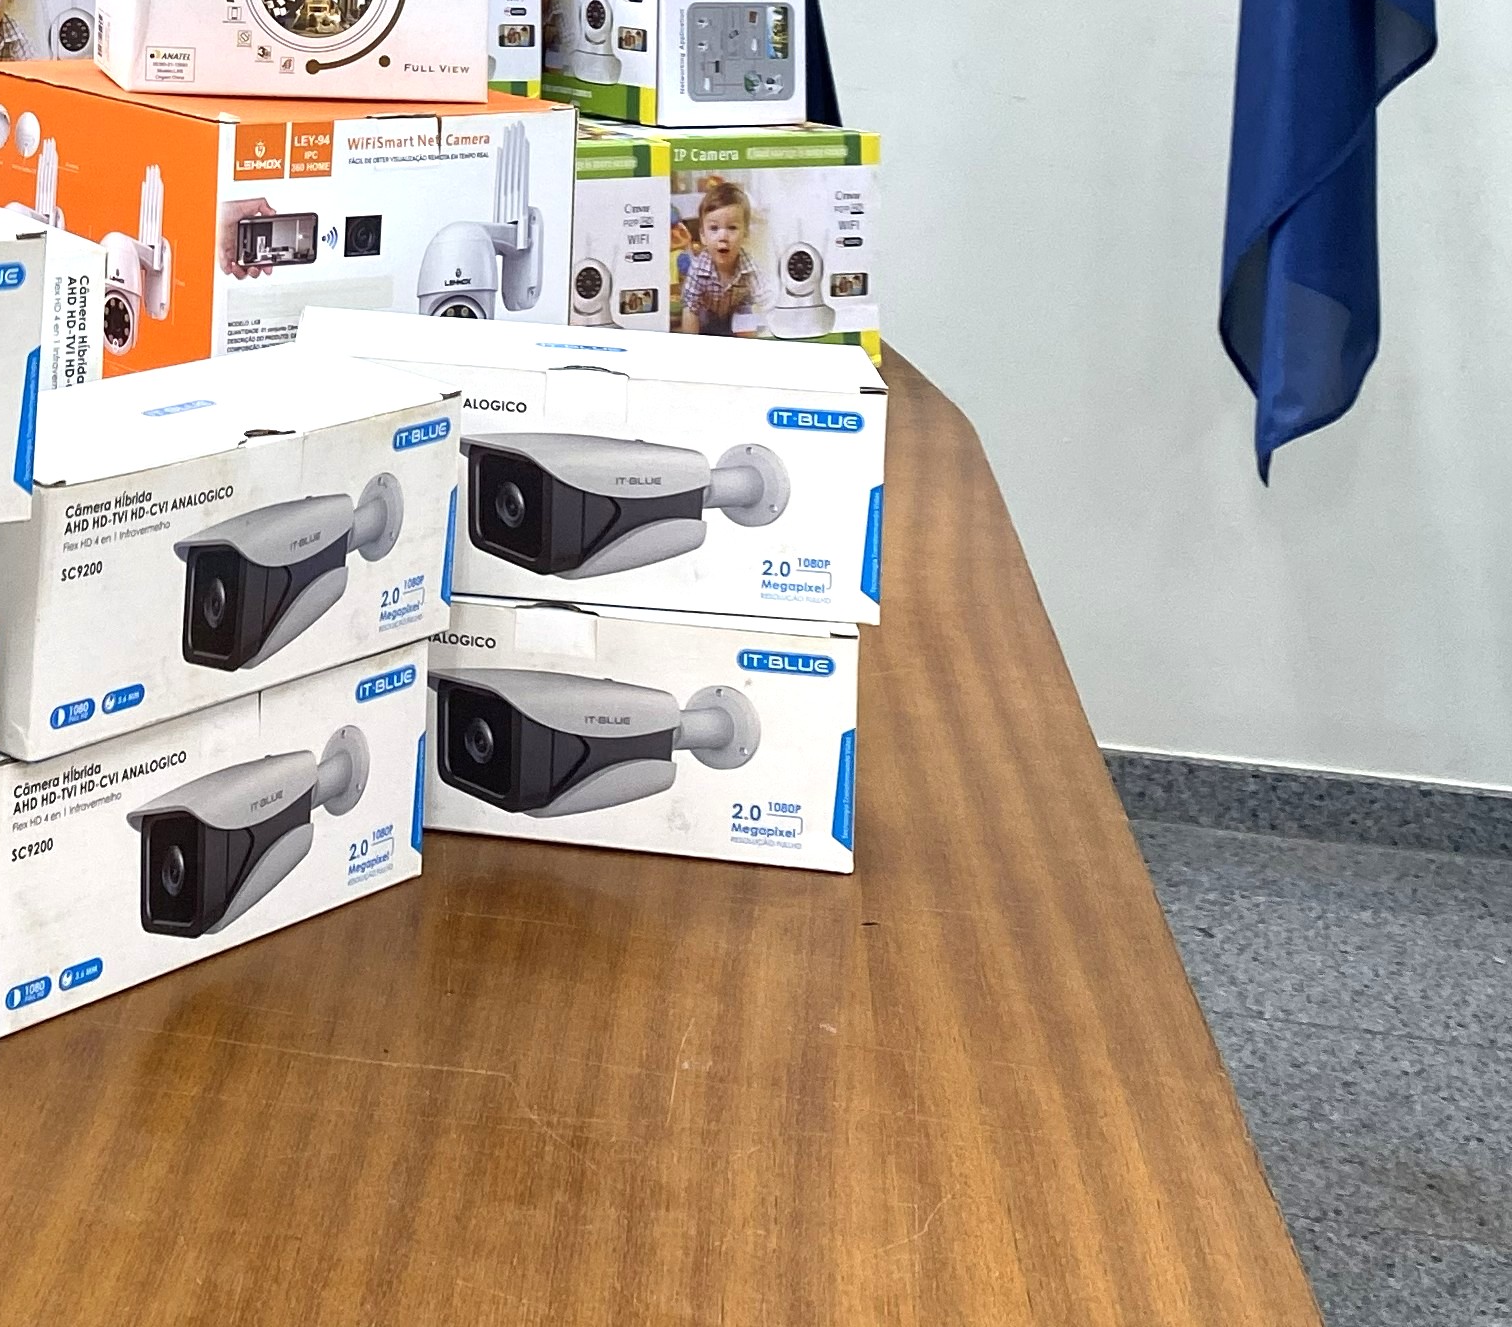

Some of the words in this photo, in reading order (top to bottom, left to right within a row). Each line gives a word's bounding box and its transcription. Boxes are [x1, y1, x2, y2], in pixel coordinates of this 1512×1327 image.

[404, 63, 433, 74] FULL
[440, 63, 470, 74] VIEW
[294, 135, 330, 148] LEY-94
[446, 133, 490, 147] Camera
[304, 151, 318, 160] IPC
[674, 149, 686, 162] IP
[691, 147, 739, 162] Camera
[306, 162, 330, 172] HOME
[68, 276, 77, 305] AHD
[78, 275, 89, 331] Câmera
[66, 310, 76, 354] HD-TVI
[463, 398, 527, 414] ALOGICO
[64, 521, 89, 535] AHD
[92, 511, 127, 529] HD-TVI
[131, 502, 168, 520] HD-CVI
[171, 485, 233, 511] ANALOGICO
[65, 500, 111, 519] Câmera
[61, 561, 102, 581] SC9200
[762, 560, 790, 578] 2.0
[797, 558, 831, 569] 1080P
[761, 580, 825, 593] Megapixel
[381, 587, 399, 607] 2.0
[13, 797, 37, 815] AHD
[41, 785, 76, 807] HD-TVI
[80, 771, 119, 794] HD-CVI
[121, 751, 187, 782] ANALOGICO
[14, 776, 59, 798] Câmera
[731, 804, 762, 821] 2.0
[768, 801, 801, 813] 1080P
[731, 823, 797, 839] Megapixel
[12, 838, 53, 862] SC9200
[349, 839, 368, 861] 2.0
[348, 851, 389, 875] Megapixel
